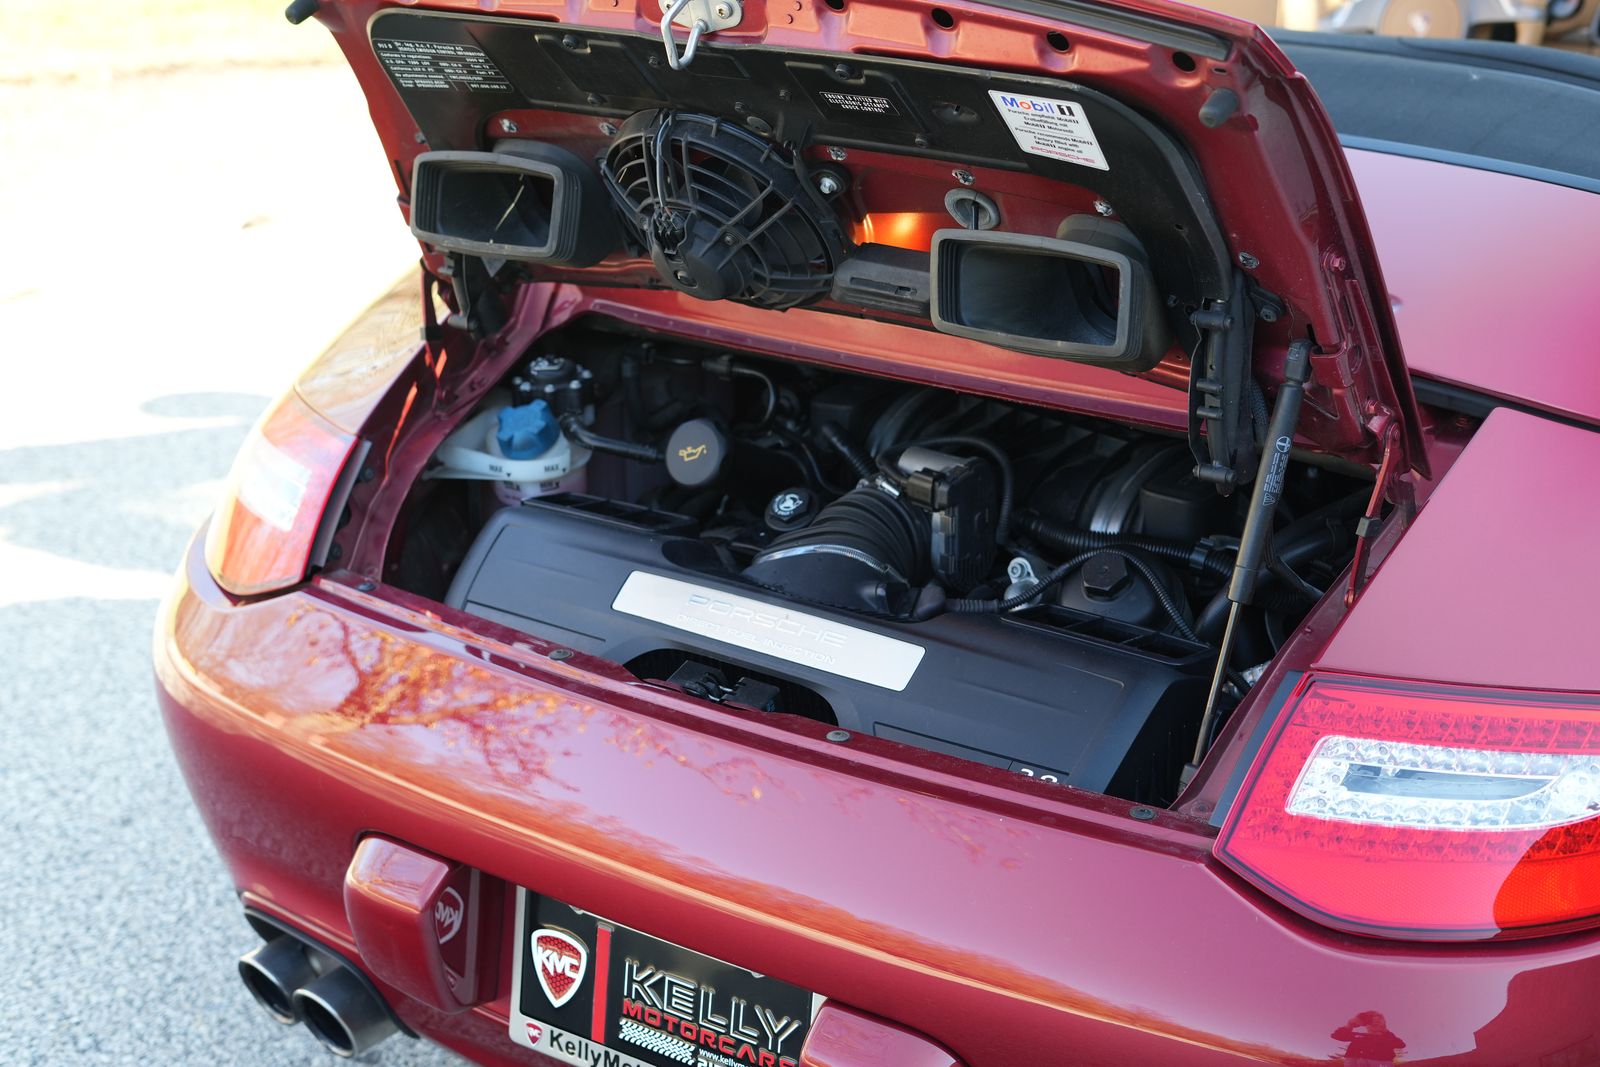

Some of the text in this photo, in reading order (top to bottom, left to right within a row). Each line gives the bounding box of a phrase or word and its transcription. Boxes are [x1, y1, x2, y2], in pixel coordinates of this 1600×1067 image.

[1001, 95, 1055, 114] Mobil
[1008, 109, 1030, 117] Porsche
[1015, 127, 1036, 135] Porsche
[1037, 131, 1071, 142] recommends
[1034, 135, 1054, 144] Factory
[1030, 145, 1096, 164] PORSCHE
[1057, 145, 1076, 153] engine
[687, 594, 848, 648] PORSCHE
[676, 614, 837, 665] DIRECT FUEL INJECTION
[537, 946, 580, 979] KMC
[623, 957, 802, 1054] KELLY
[549, 1029, 640, 1067] KellyM
